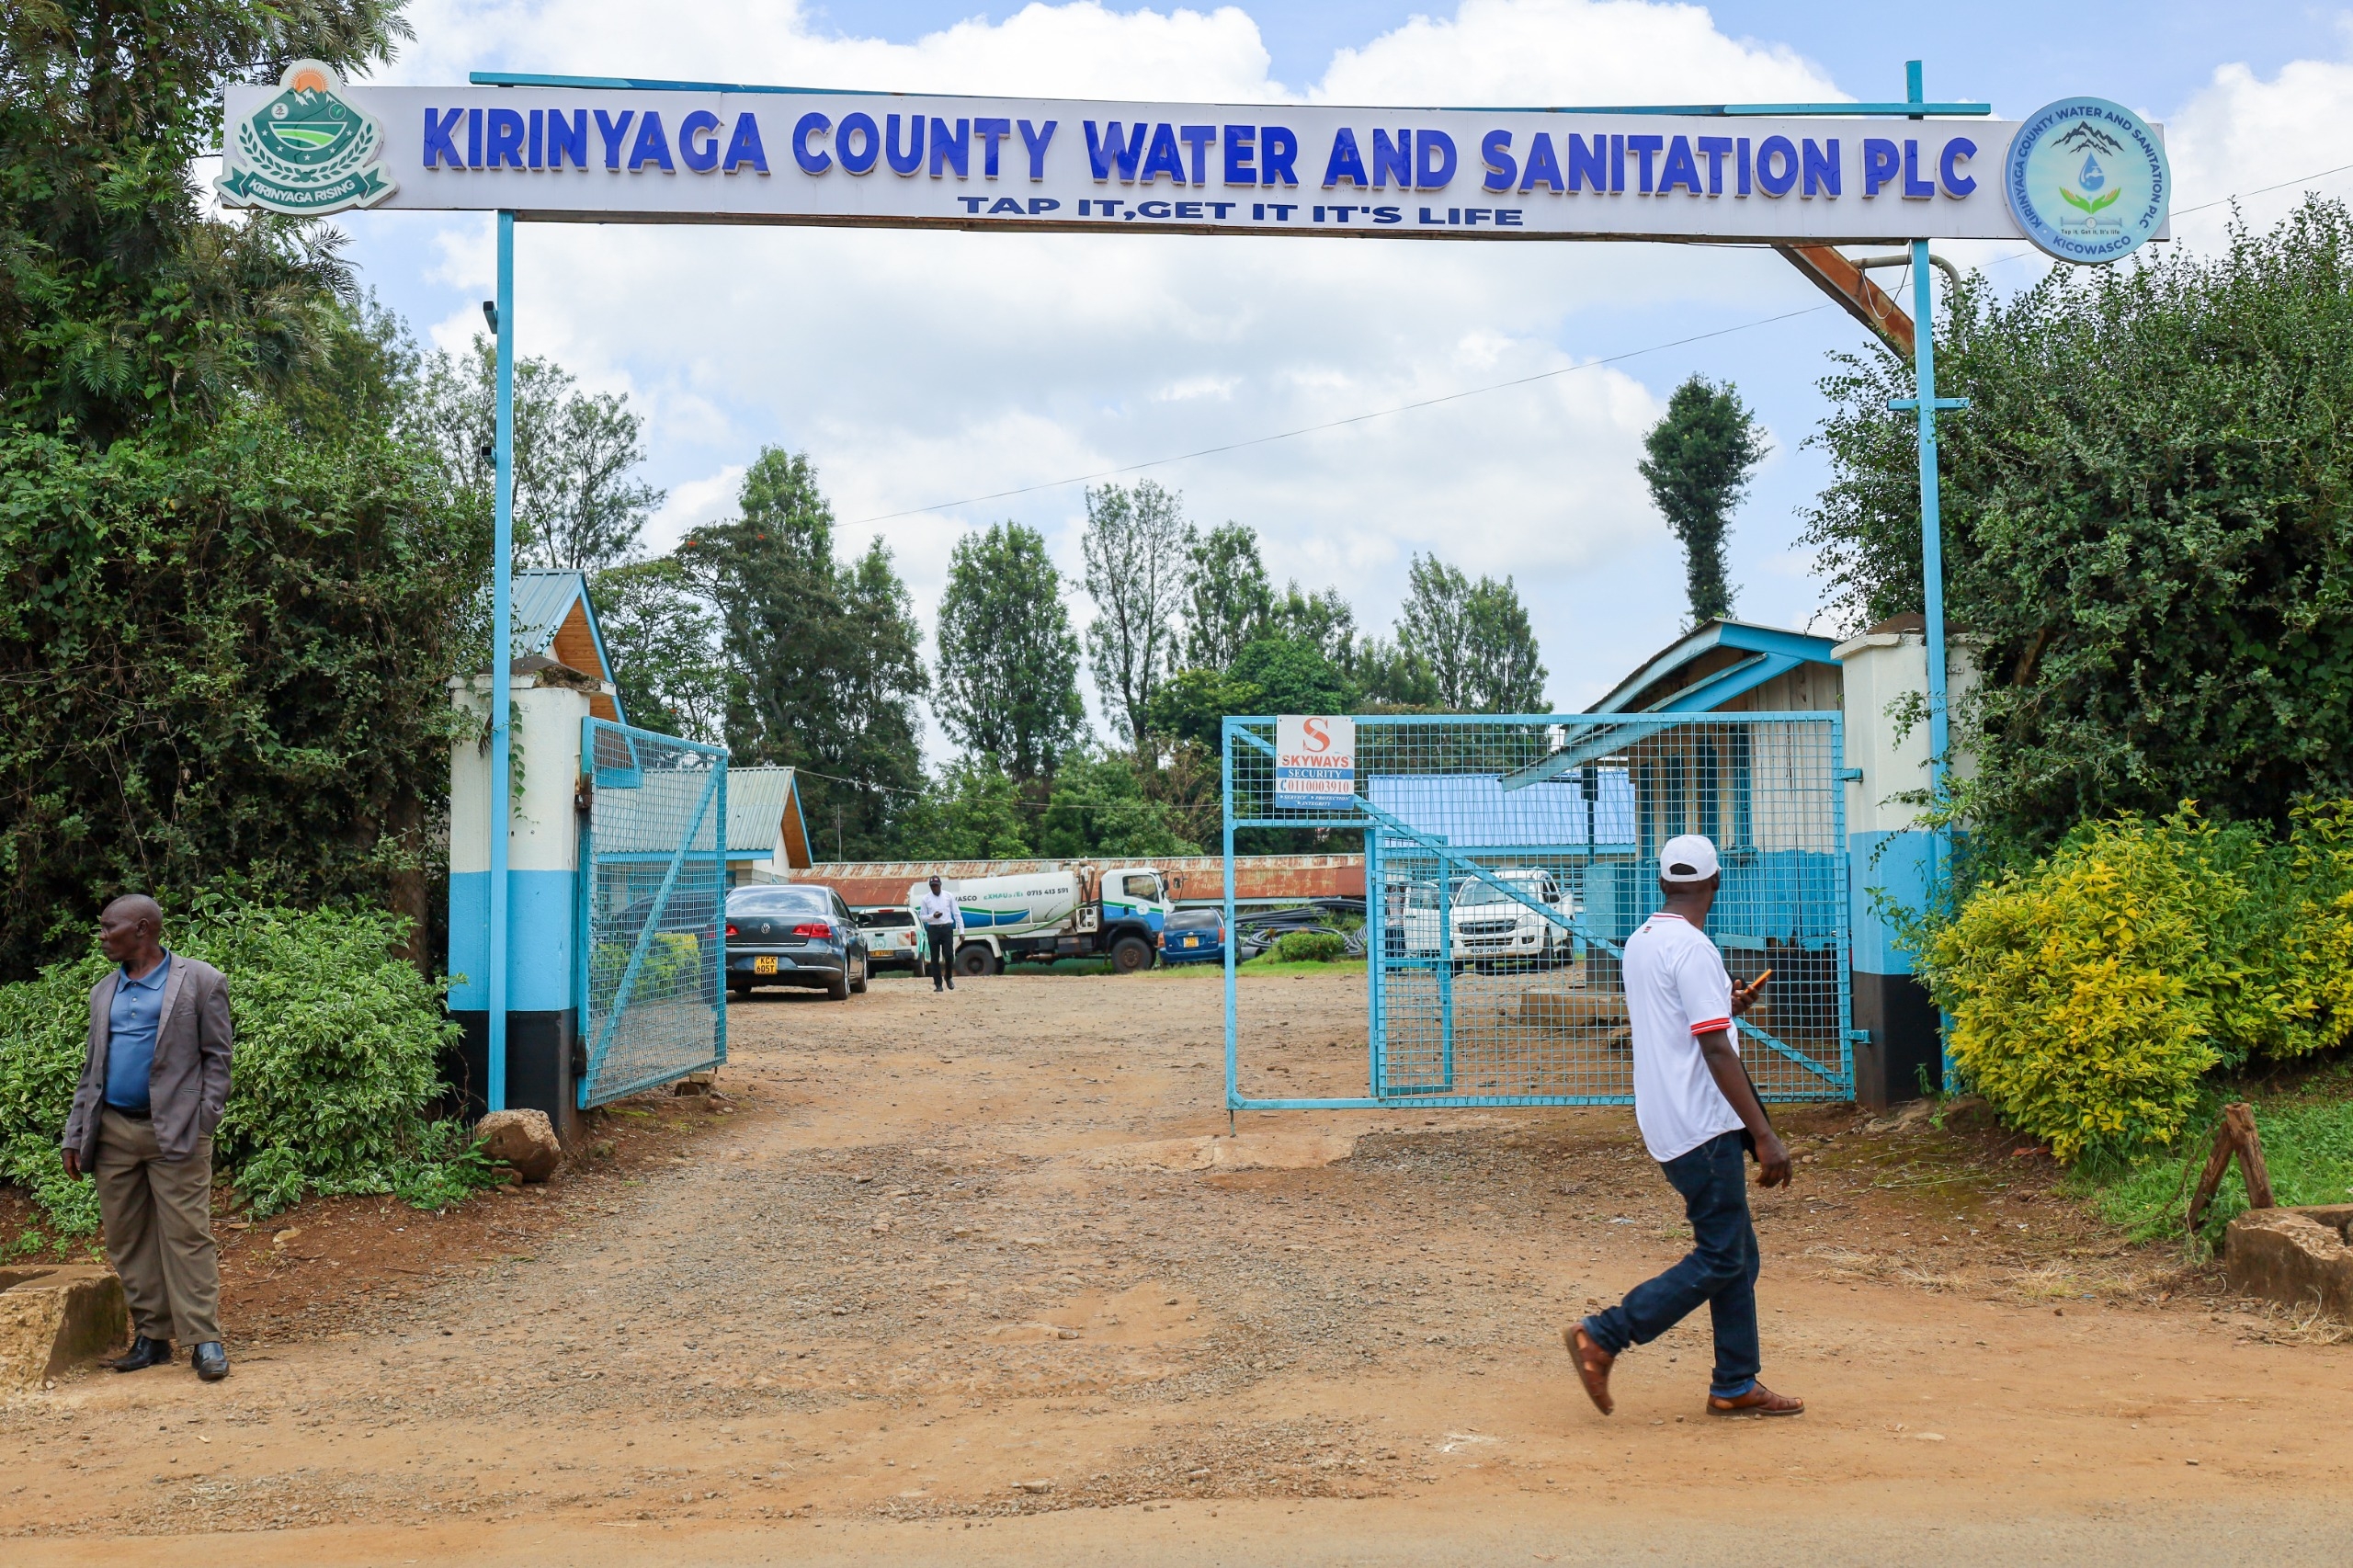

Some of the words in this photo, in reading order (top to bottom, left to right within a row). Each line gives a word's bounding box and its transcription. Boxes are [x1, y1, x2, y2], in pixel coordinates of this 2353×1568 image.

[2055, 106, 2103, 120] WATER
[2104, 111, 2132, 131] AND
[2018, 114, 2054, 158] COUNTY
[423, 108, 768, 173] KIRINYAGA
[792, 112, 1057, 178] COUNTY
[1083, 120, 1299, 185] WATER
[1324, 128, 1458, 188] AND
[1481, 130, 1842, 197] SANITATION
[1863, 138, 1978, 197] PLC
[2131, 129, 2163, 203] SANITATION
[247, 178, 313, 203] KIRINYAGA
[314, 179, 356, 202] RISING
[2014, 161, 2042, 229] KIRINYAGA
[958, 197, 1060, 215] TAP
[1253, 203, 1299, 222] IT
[1313, 206, 1402, 224] IT'S
[1419, 208, 1523, 226] LIFE
[2139, 205, 2158, 229] PLC
[2052, 235, 2131, 255] KICOWASCO
[1303, 718, 1331, 753] S
[1282, 755, 1349, 767] SKYWAYS
[1288, 769, 1343, 778] SECURITY
[1288, 779, 1349, 793] 0110003910
